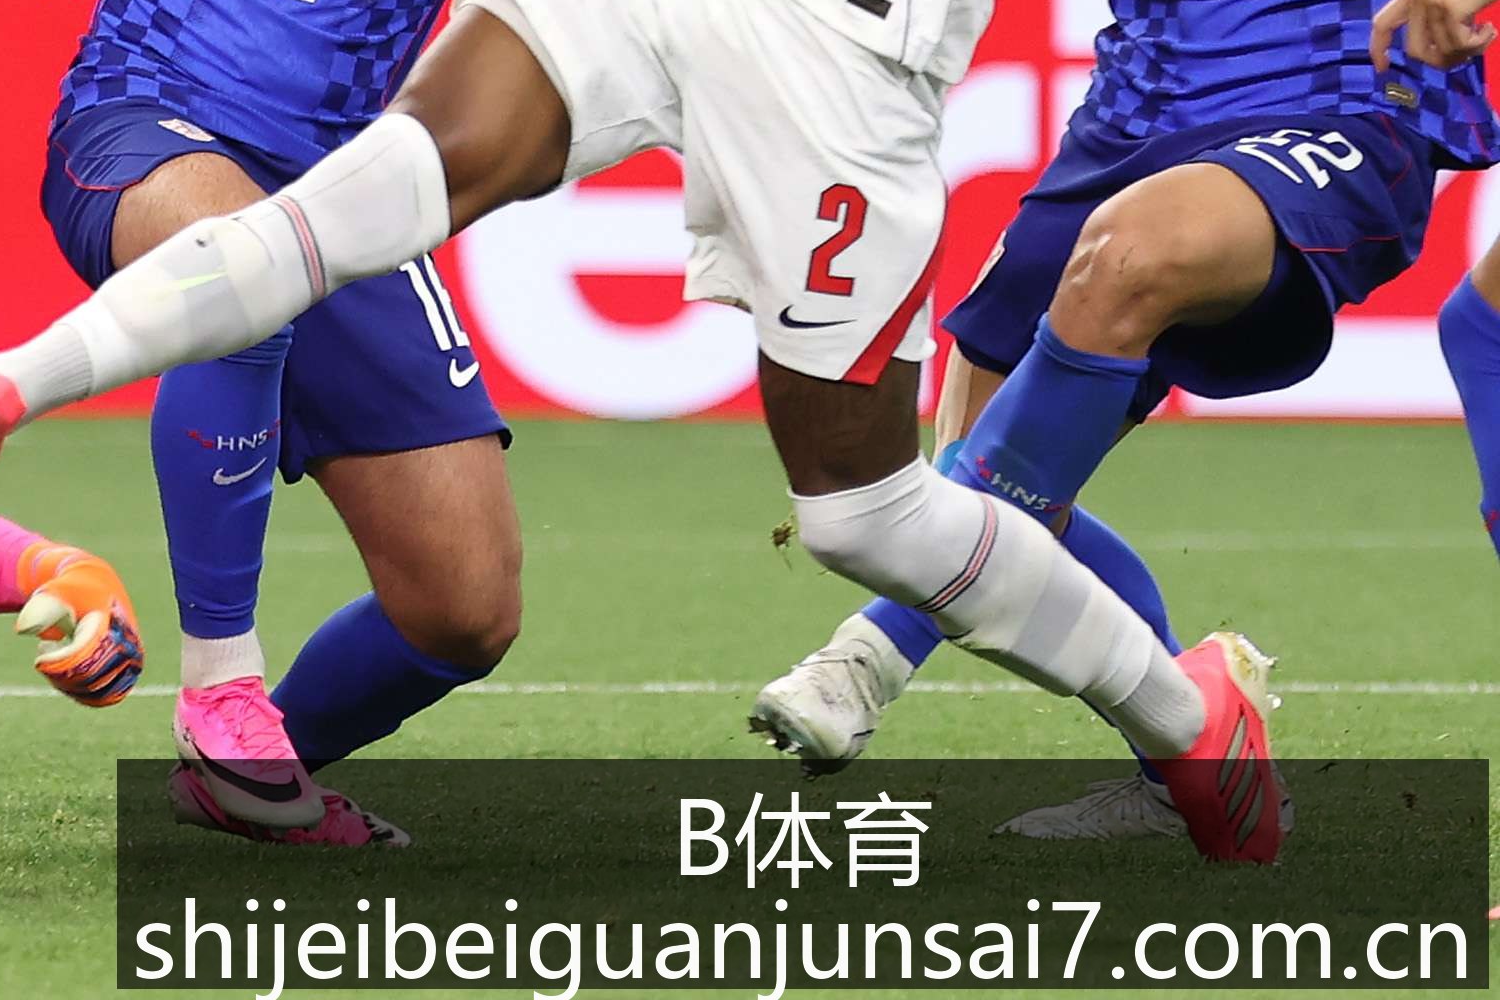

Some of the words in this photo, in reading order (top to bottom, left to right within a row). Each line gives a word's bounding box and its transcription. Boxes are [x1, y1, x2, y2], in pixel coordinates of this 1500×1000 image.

[805, 182, 869, 297] 2
[217, 429, 268, 451] HNS
[991, 472, 1051, 511] HNS
